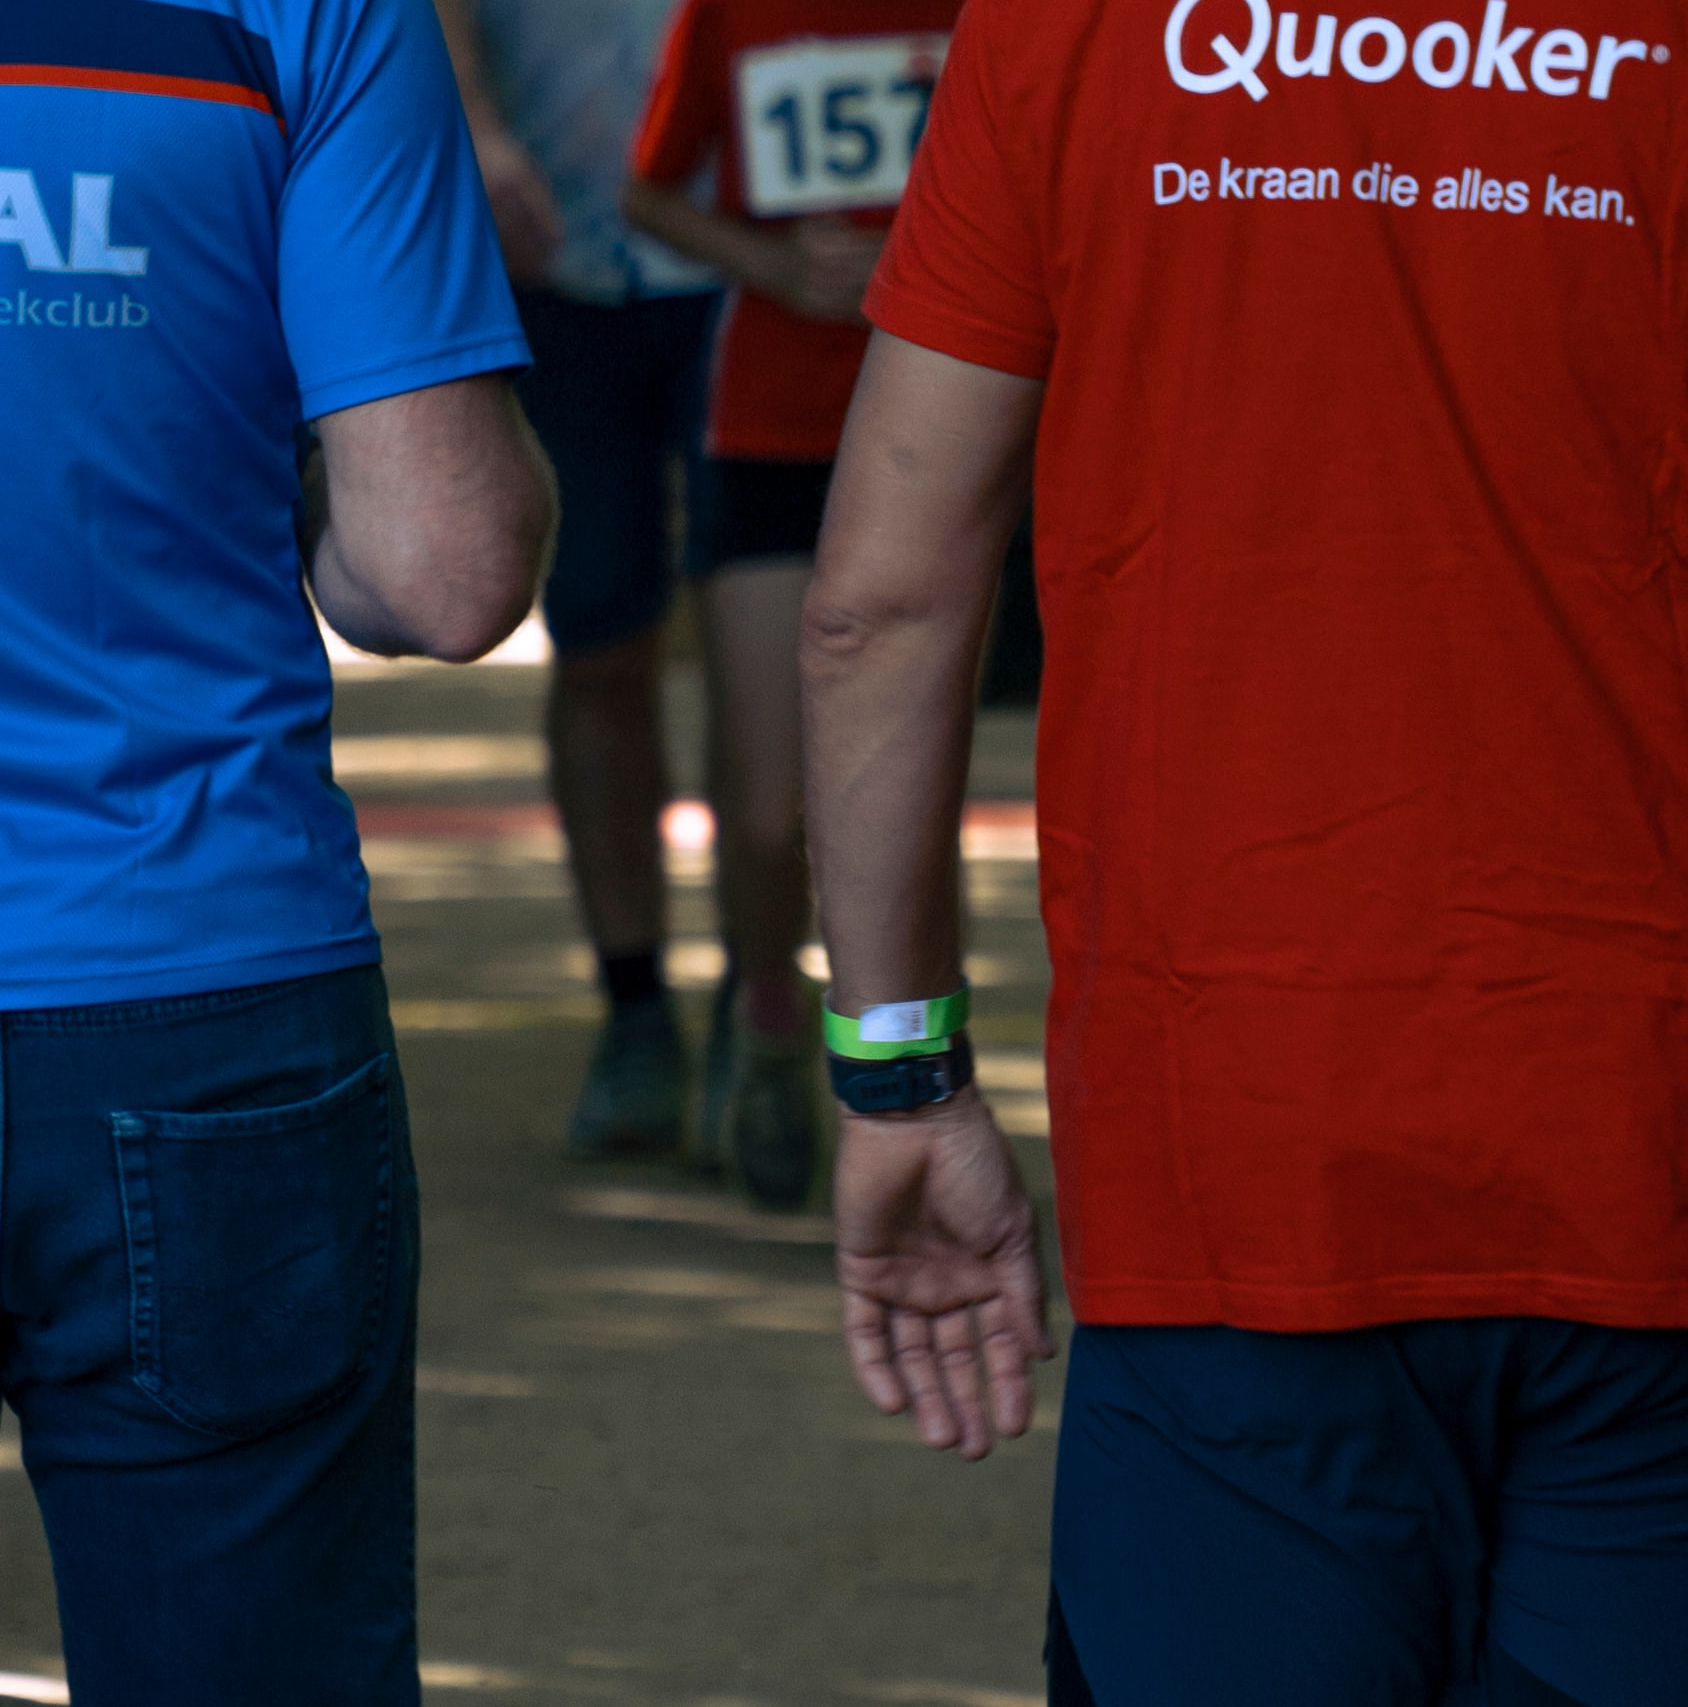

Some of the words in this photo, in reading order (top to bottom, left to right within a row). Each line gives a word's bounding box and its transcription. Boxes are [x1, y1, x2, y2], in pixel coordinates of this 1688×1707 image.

[1153, 162, 1210, 206] De
[1218, 157, 1339, 200] kraan
[1352, 162, 1419, 207] die
[1432, 168, 1530, 215] alles
[1544, 174, 1636, 227] kan.
